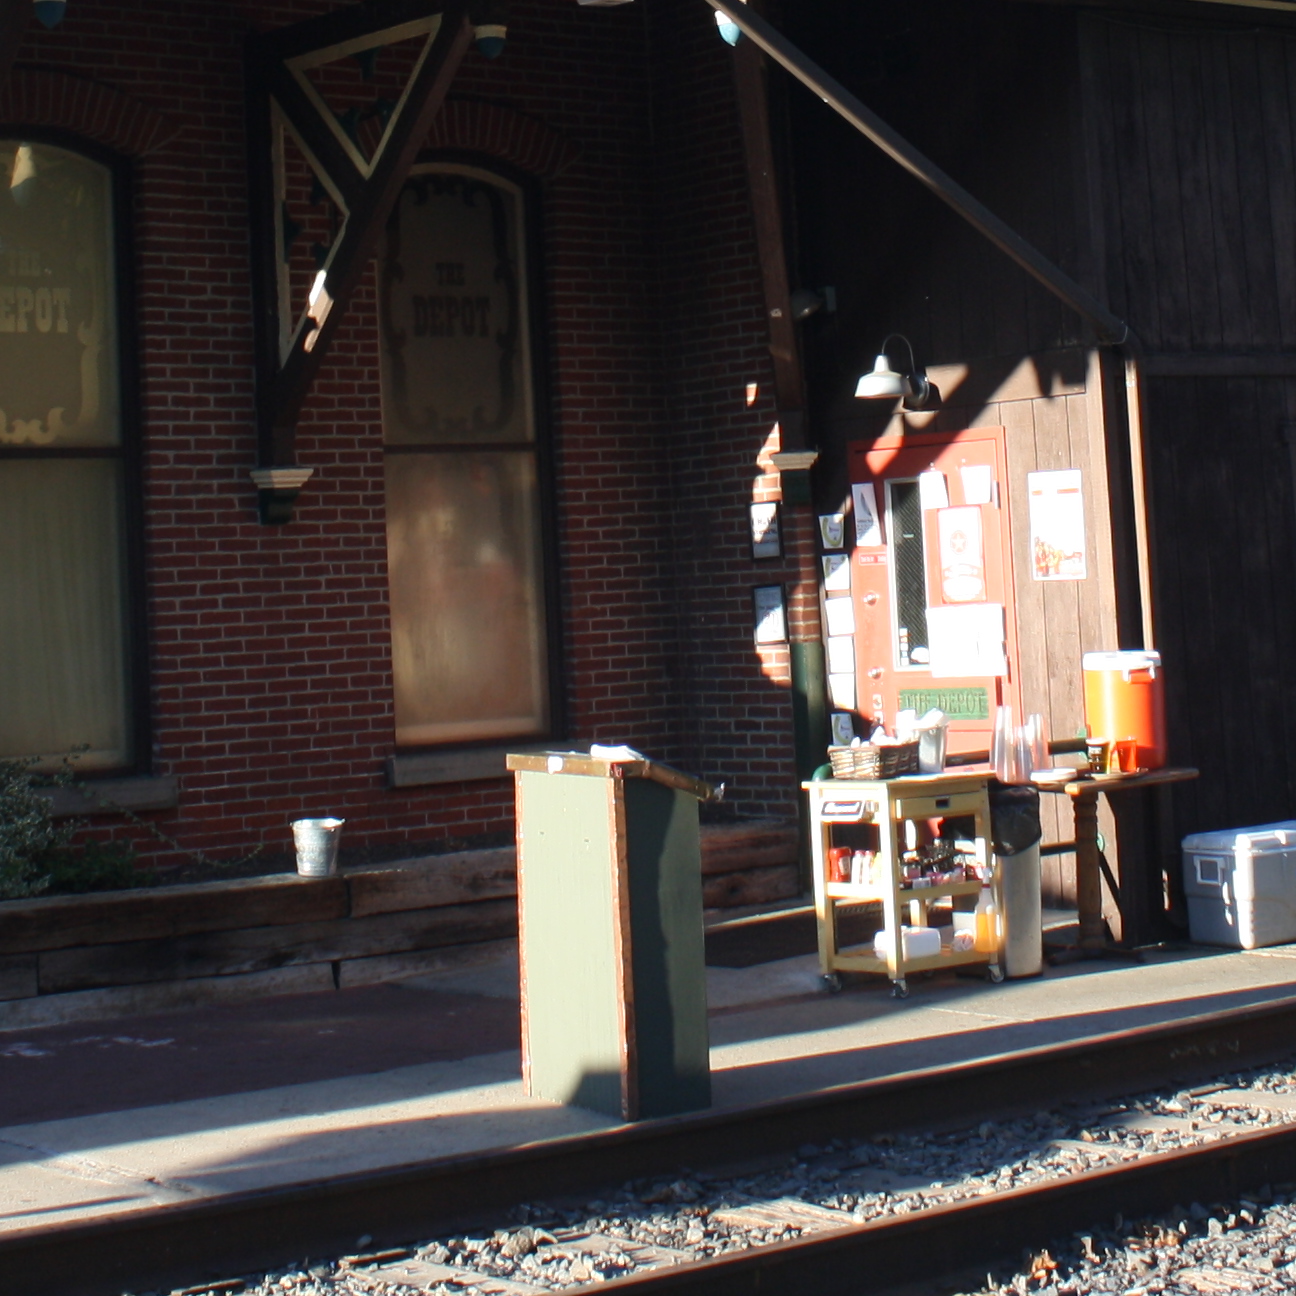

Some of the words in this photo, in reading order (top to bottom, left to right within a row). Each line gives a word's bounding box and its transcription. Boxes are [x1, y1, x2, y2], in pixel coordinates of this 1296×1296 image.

[8, 251, 42, 276] THE
[435, 262, 465, 285] THE
[412, 296, 489, 337] DEPOT
[937, 691, 985, 714] DEPOT
